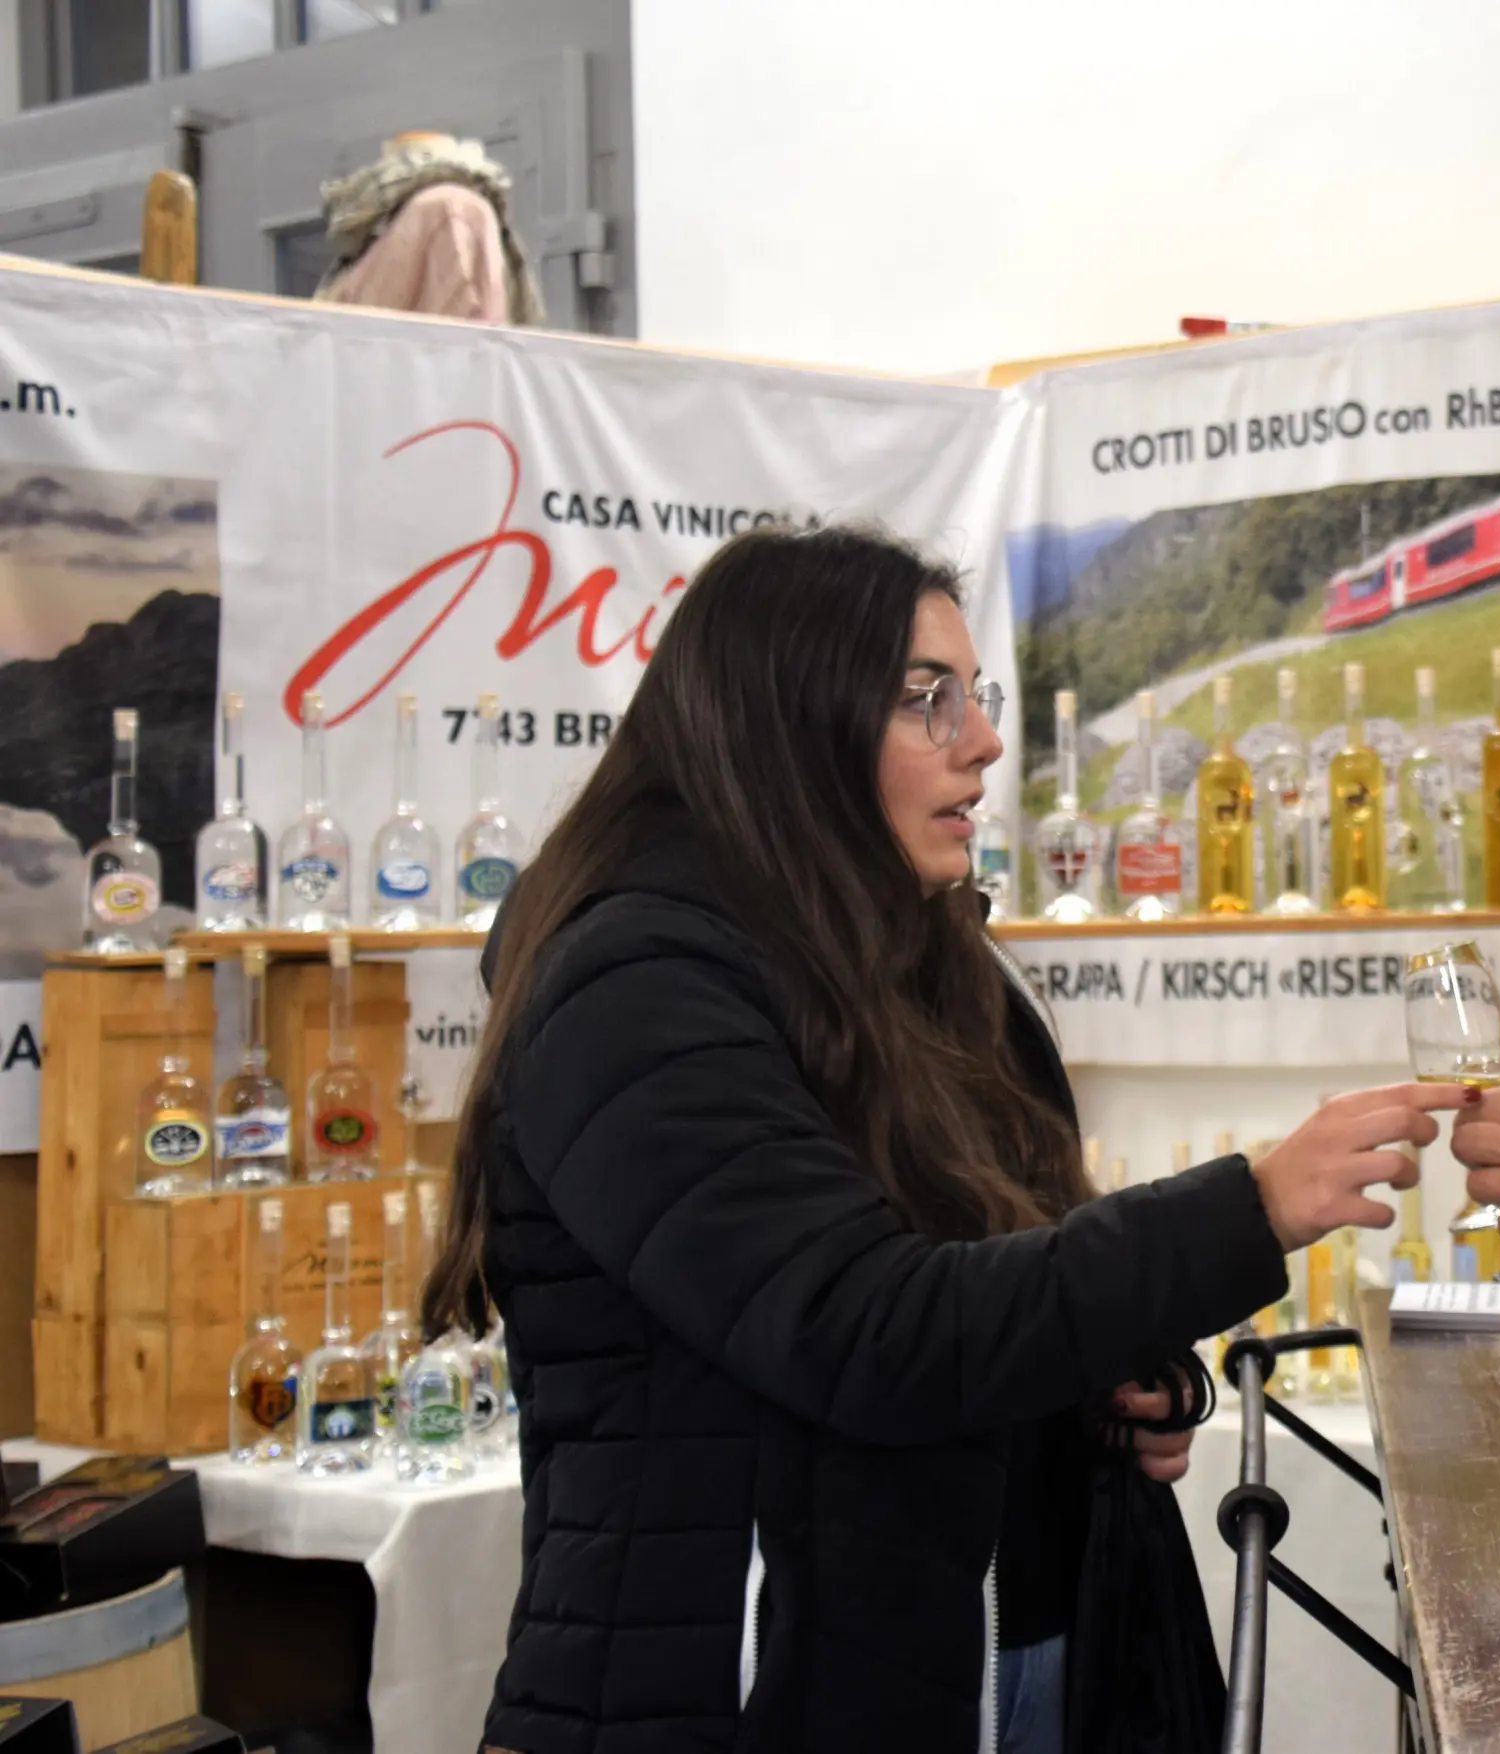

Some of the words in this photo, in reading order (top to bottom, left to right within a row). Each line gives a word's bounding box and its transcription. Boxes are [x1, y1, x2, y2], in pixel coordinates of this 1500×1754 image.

[1092, 427, 1195, 475] CROTTI
[1205, 421, 1238, 461] DI
[1247, 400, 1366, 454] BRUSIO
[1374, 405, 1430, 435] con
[541, 489, 642, 532] CASA
[442, 708, 537, 747] 743
[1162, 958, 1269, 1001] KIRSCH
[1278, 953, 1402, 1002] «RISER
